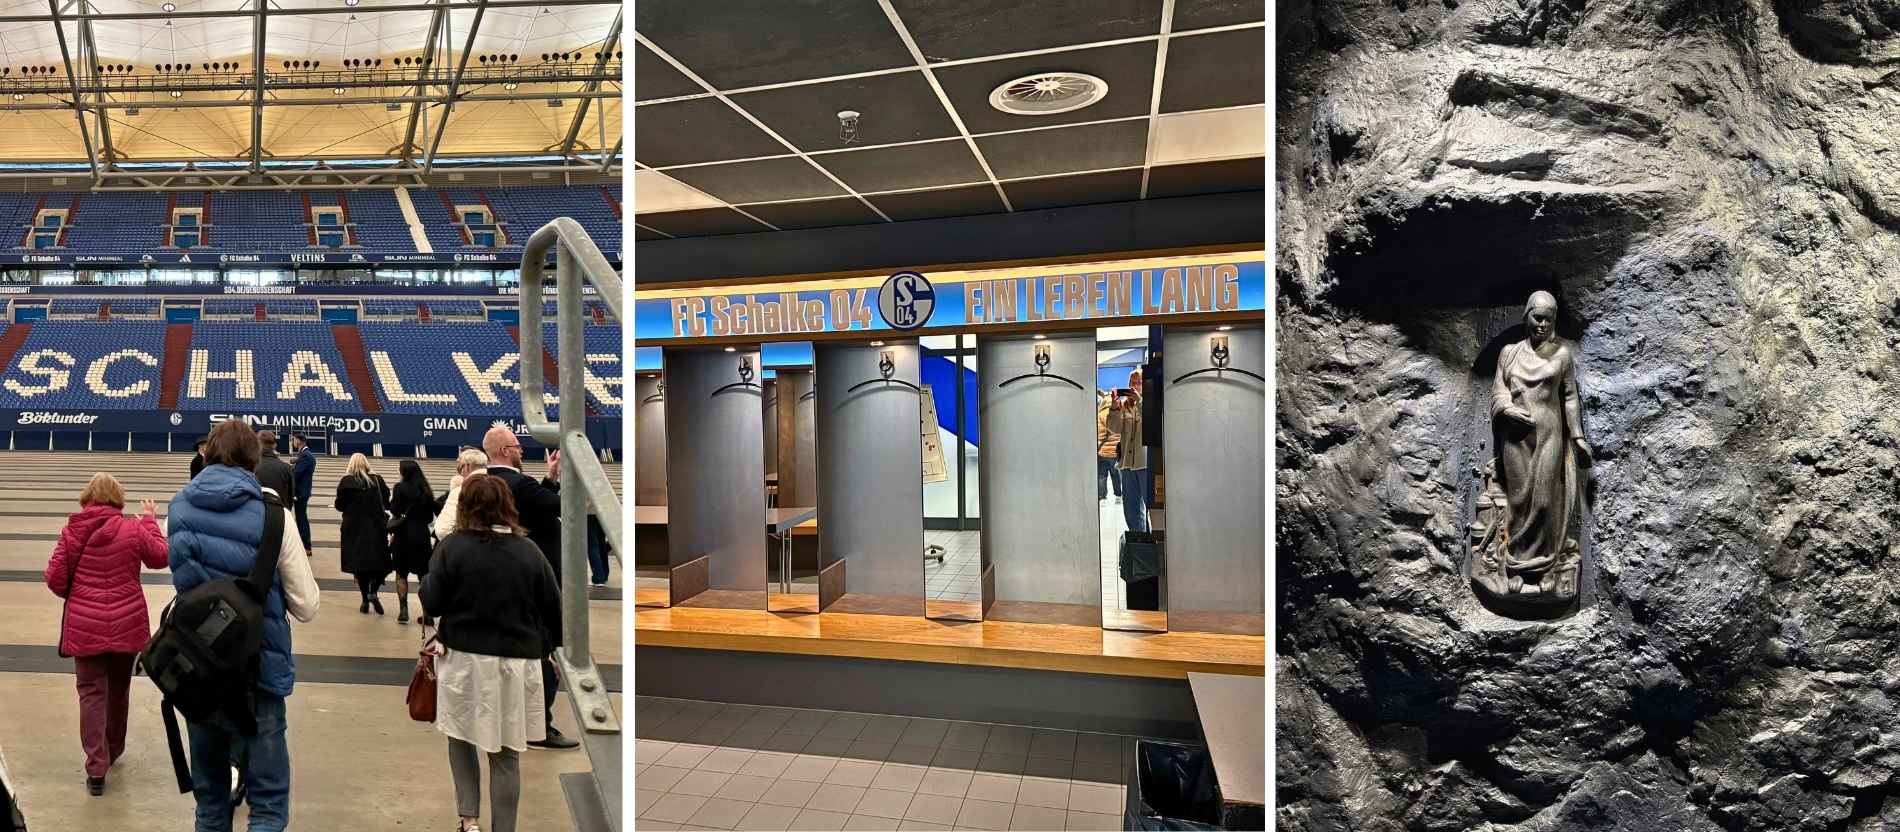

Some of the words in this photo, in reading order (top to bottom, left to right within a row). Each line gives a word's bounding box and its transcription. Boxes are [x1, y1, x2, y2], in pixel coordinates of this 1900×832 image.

[290, 254, 326, 262] VELTINS
[963, 278, 1017, 324] EIN
[1025, 271, 1132, 321] LEBEN
[1141, 264, 1239, 315] LANG
[670, 296, 706, 337] FC
[710, 291, 825, 334] Schalke
[829, 288, 873, 331] 04
[17, 411, 98, 424] Böklunder
